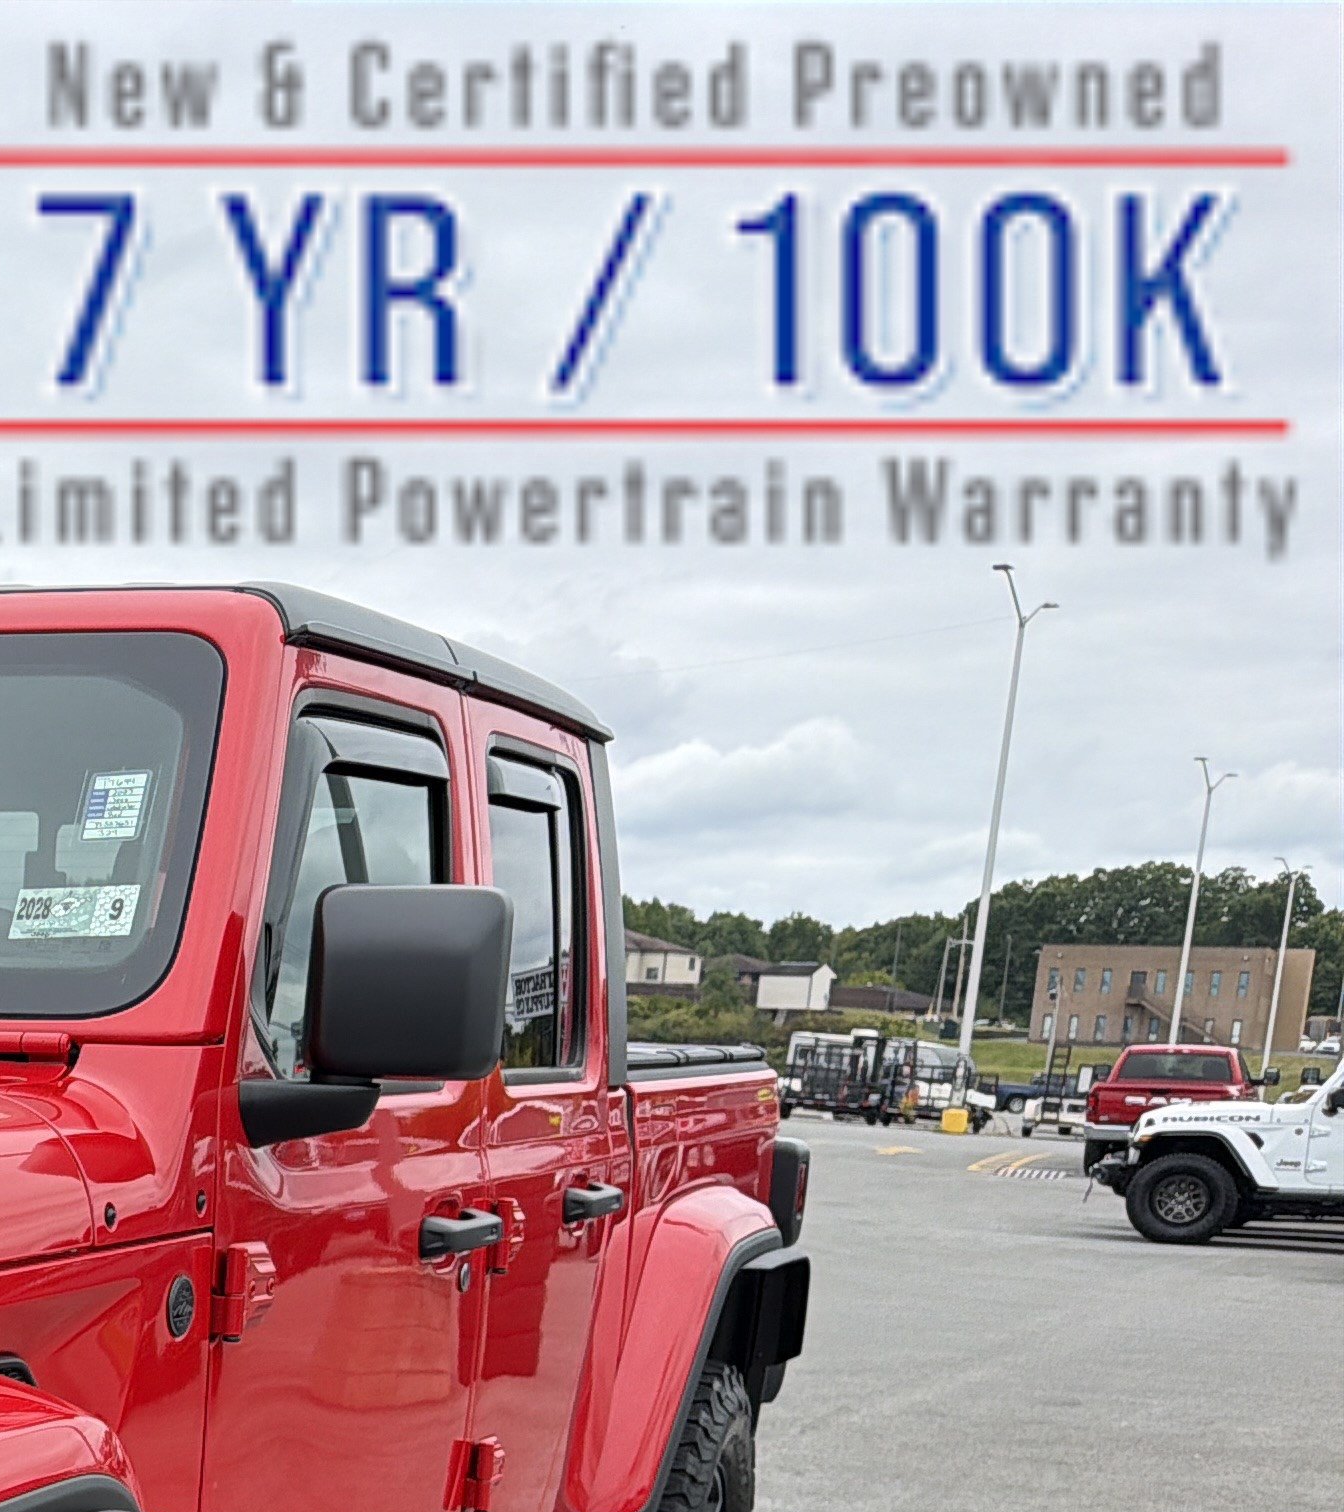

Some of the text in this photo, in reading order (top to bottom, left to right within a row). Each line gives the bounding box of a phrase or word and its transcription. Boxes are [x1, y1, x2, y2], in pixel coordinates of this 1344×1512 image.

[16, 897, 53, 920] 2028
[109, 898, 125, 920] 9
[1162, 1115, 1261, 1123] RUBICON
